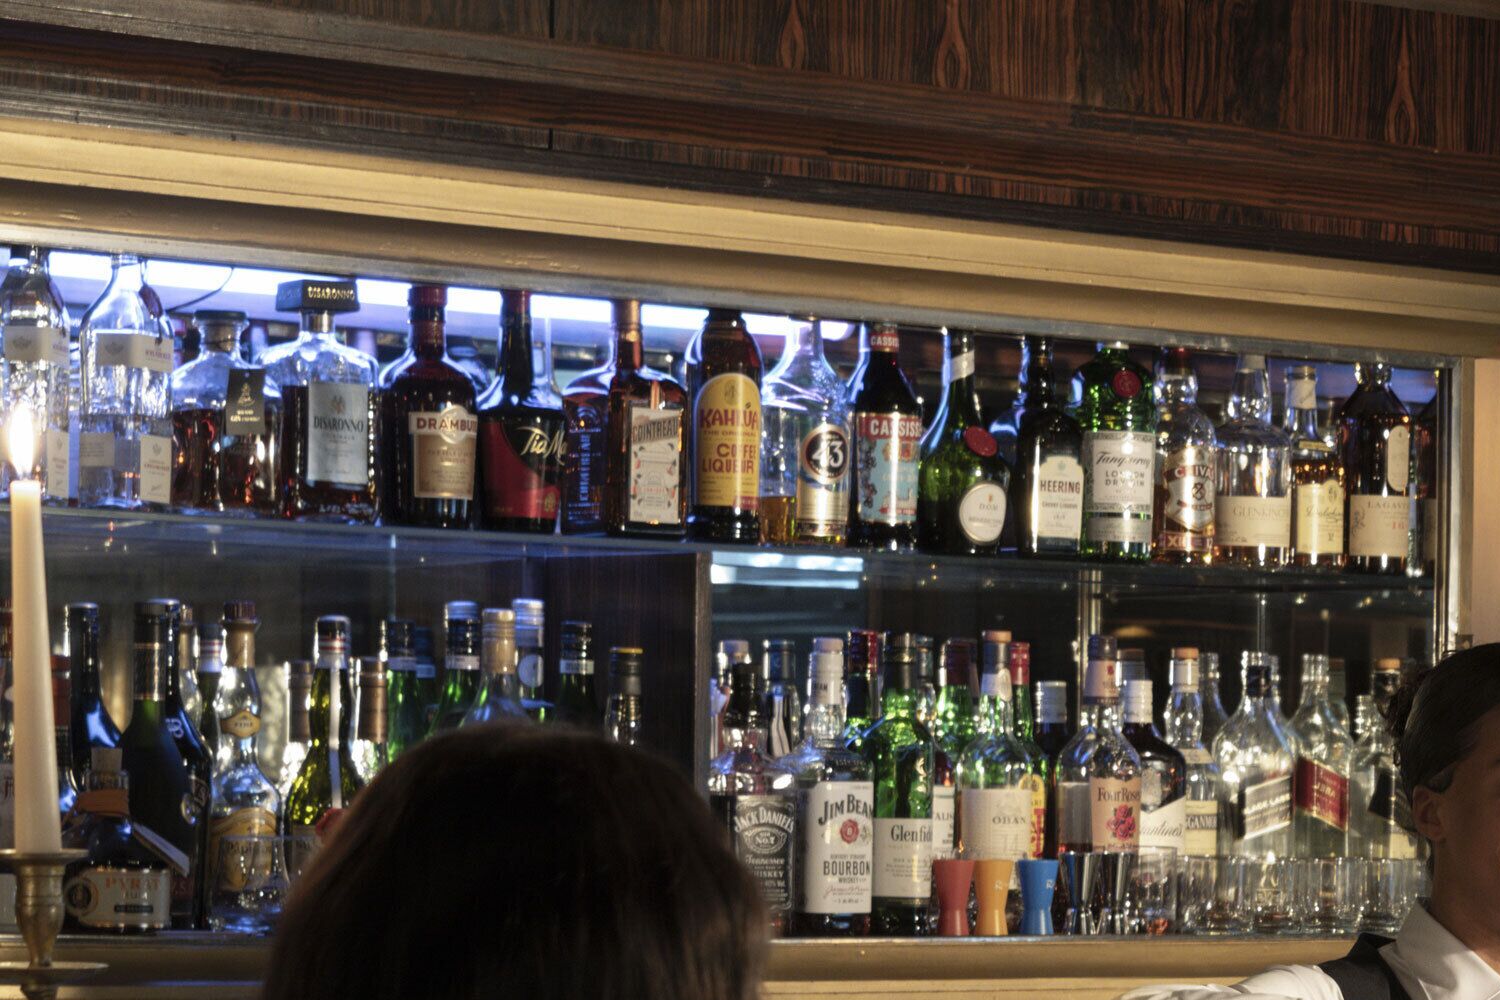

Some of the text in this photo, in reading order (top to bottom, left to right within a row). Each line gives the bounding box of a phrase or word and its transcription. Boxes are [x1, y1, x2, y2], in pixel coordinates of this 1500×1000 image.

[308, 286, 355, 301] DISARONNO
[313, 415, 364, 432] DISARONNO
[632, 415, 678, 443] COINTREAU
[516, 426, 549, 456] Tia
[716, 443, 757, 460] COFEE
[811, 440, 844, 469] 43
[1094, 451, 1152, 468] Tanqeray
[702, 458, 755, 475] LIQUEUR
[1105, 471, 1145, 479] LOON
[1039, 479, 1081, 495] HEERING
[1098, 786, 1121, 802] Four
[734, 806, 795, 834] JACK DANIEL'S
[818, 800, 844, 826] JIM
[992, 815, 1027, 825] OBAN
[890, 824, 933, 843] Glenfid
[745, 854, 786, 865] Tennessee
[823, 860, 870, 877] BOURBON
